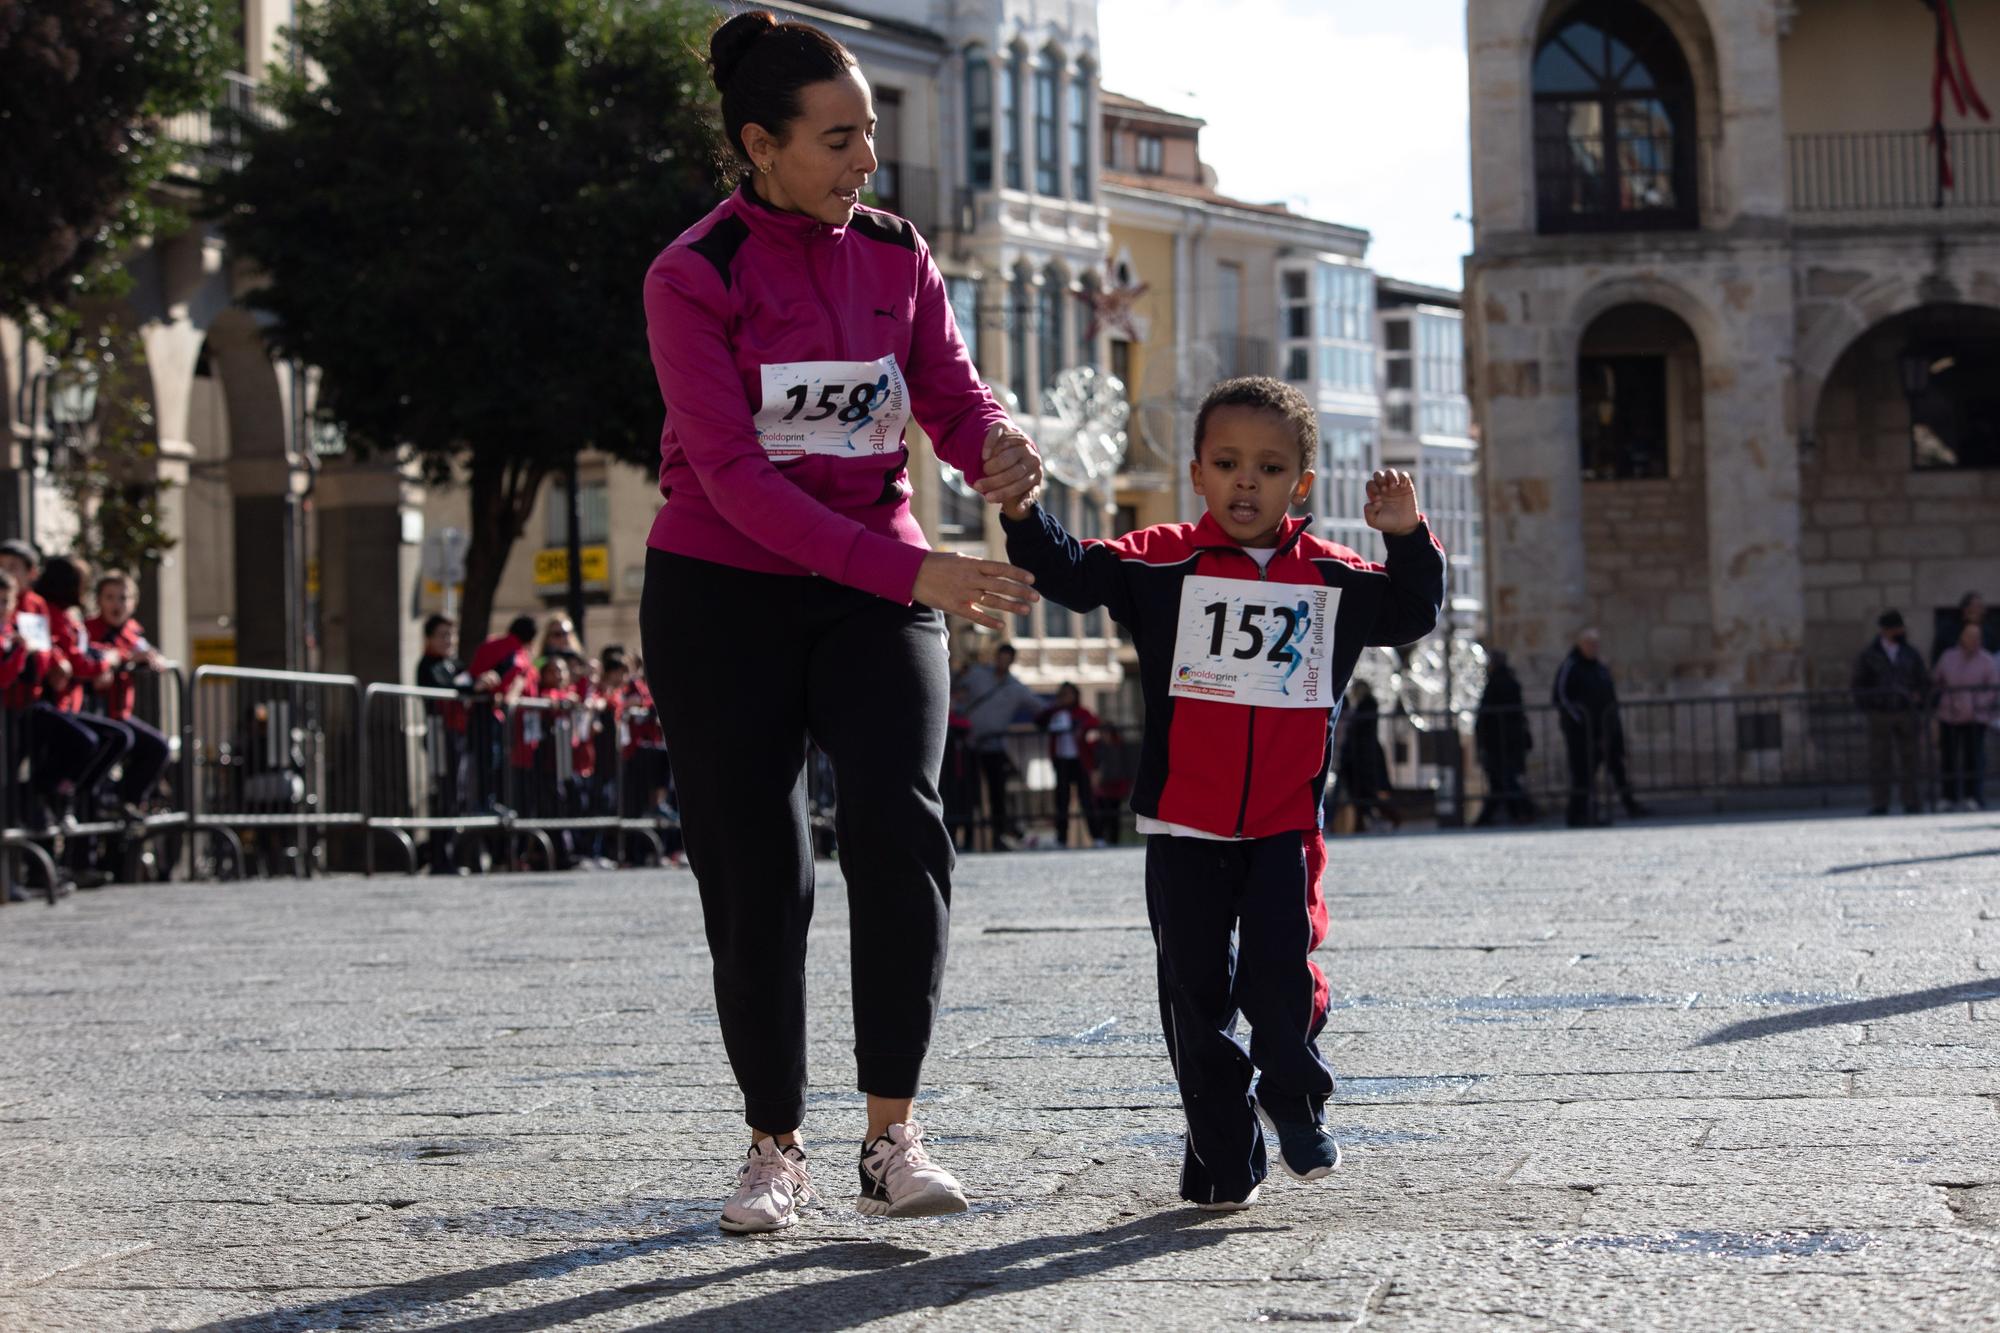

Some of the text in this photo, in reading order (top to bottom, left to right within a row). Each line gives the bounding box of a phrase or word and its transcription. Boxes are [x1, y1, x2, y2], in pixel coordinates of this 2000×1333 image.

[782, 383, 875, 422] 158
[759, 432, 804, 443] moldoprint
[1204, 601, 1296, 663] 152
[1313, 590, 1328, 645] solidaridad
[1188, 671, 1238, 683] moldoprint
[1303, 664, 1320, 703] taller
